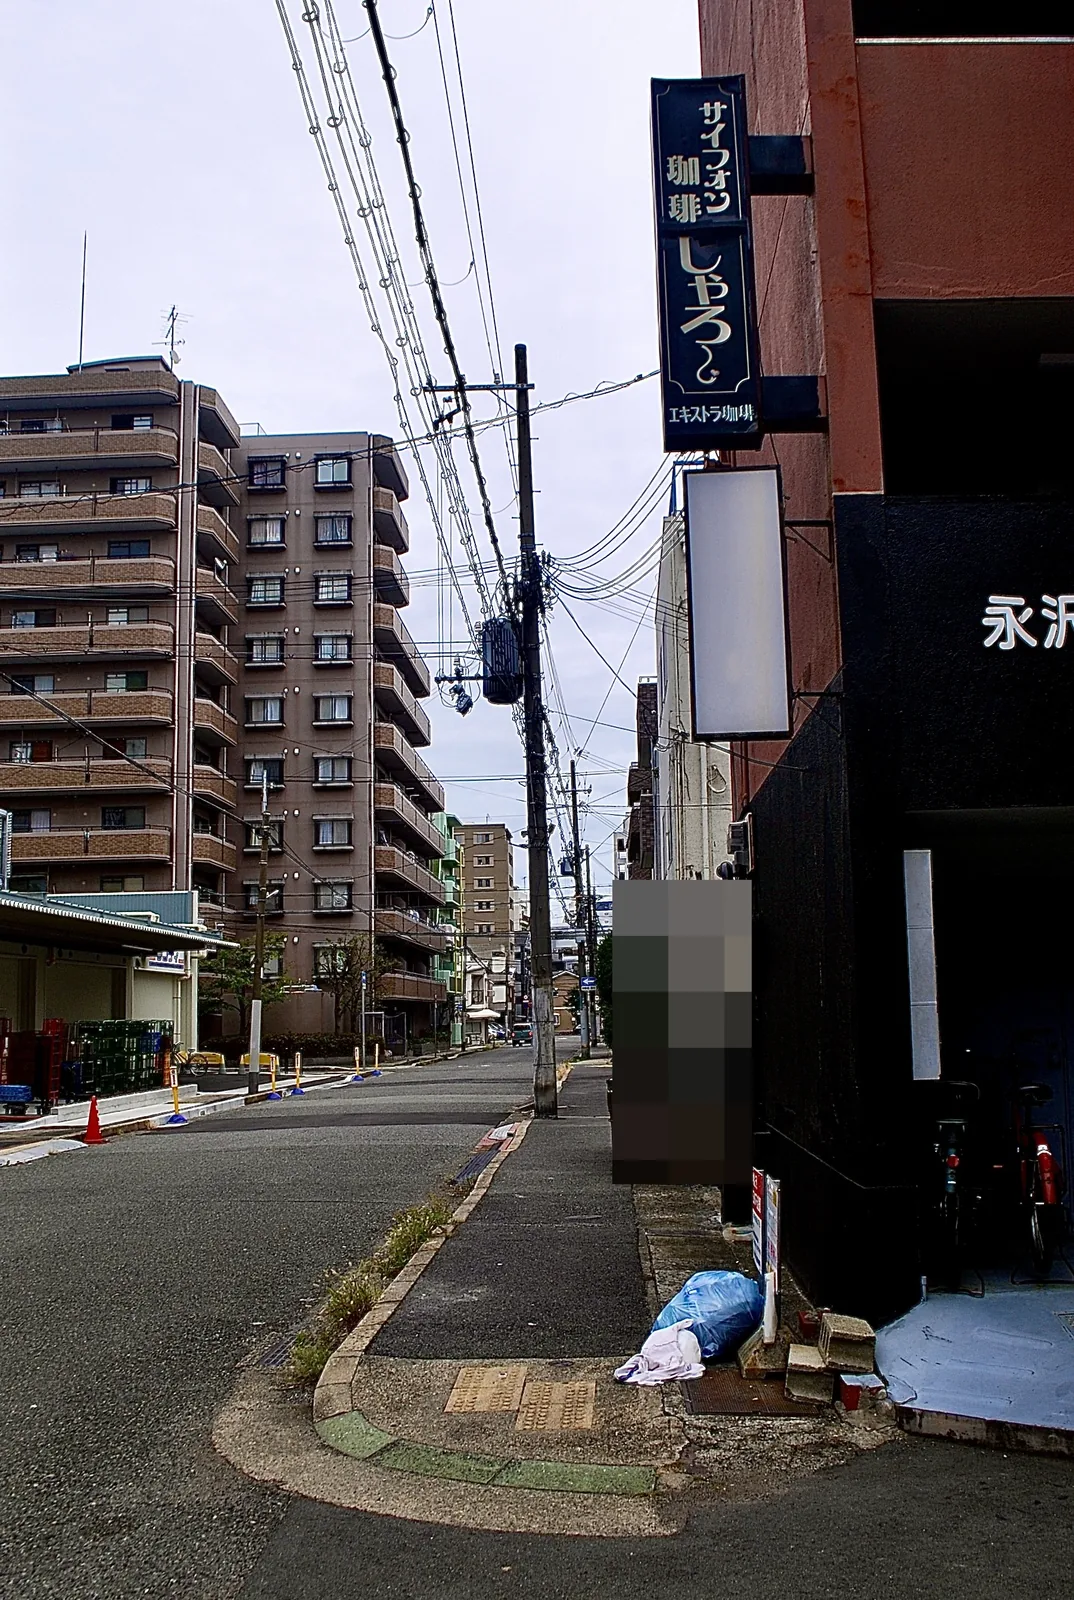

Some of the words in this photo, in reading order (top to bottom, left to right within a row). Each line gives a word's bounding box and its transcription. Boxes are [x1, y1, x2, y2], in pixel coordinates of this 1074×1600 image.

[666, 155, 702, 223] 珈琲
[698, 101, 731, 214] サイフォン
[669, 404, 754, 423] エキストラ珈琲
